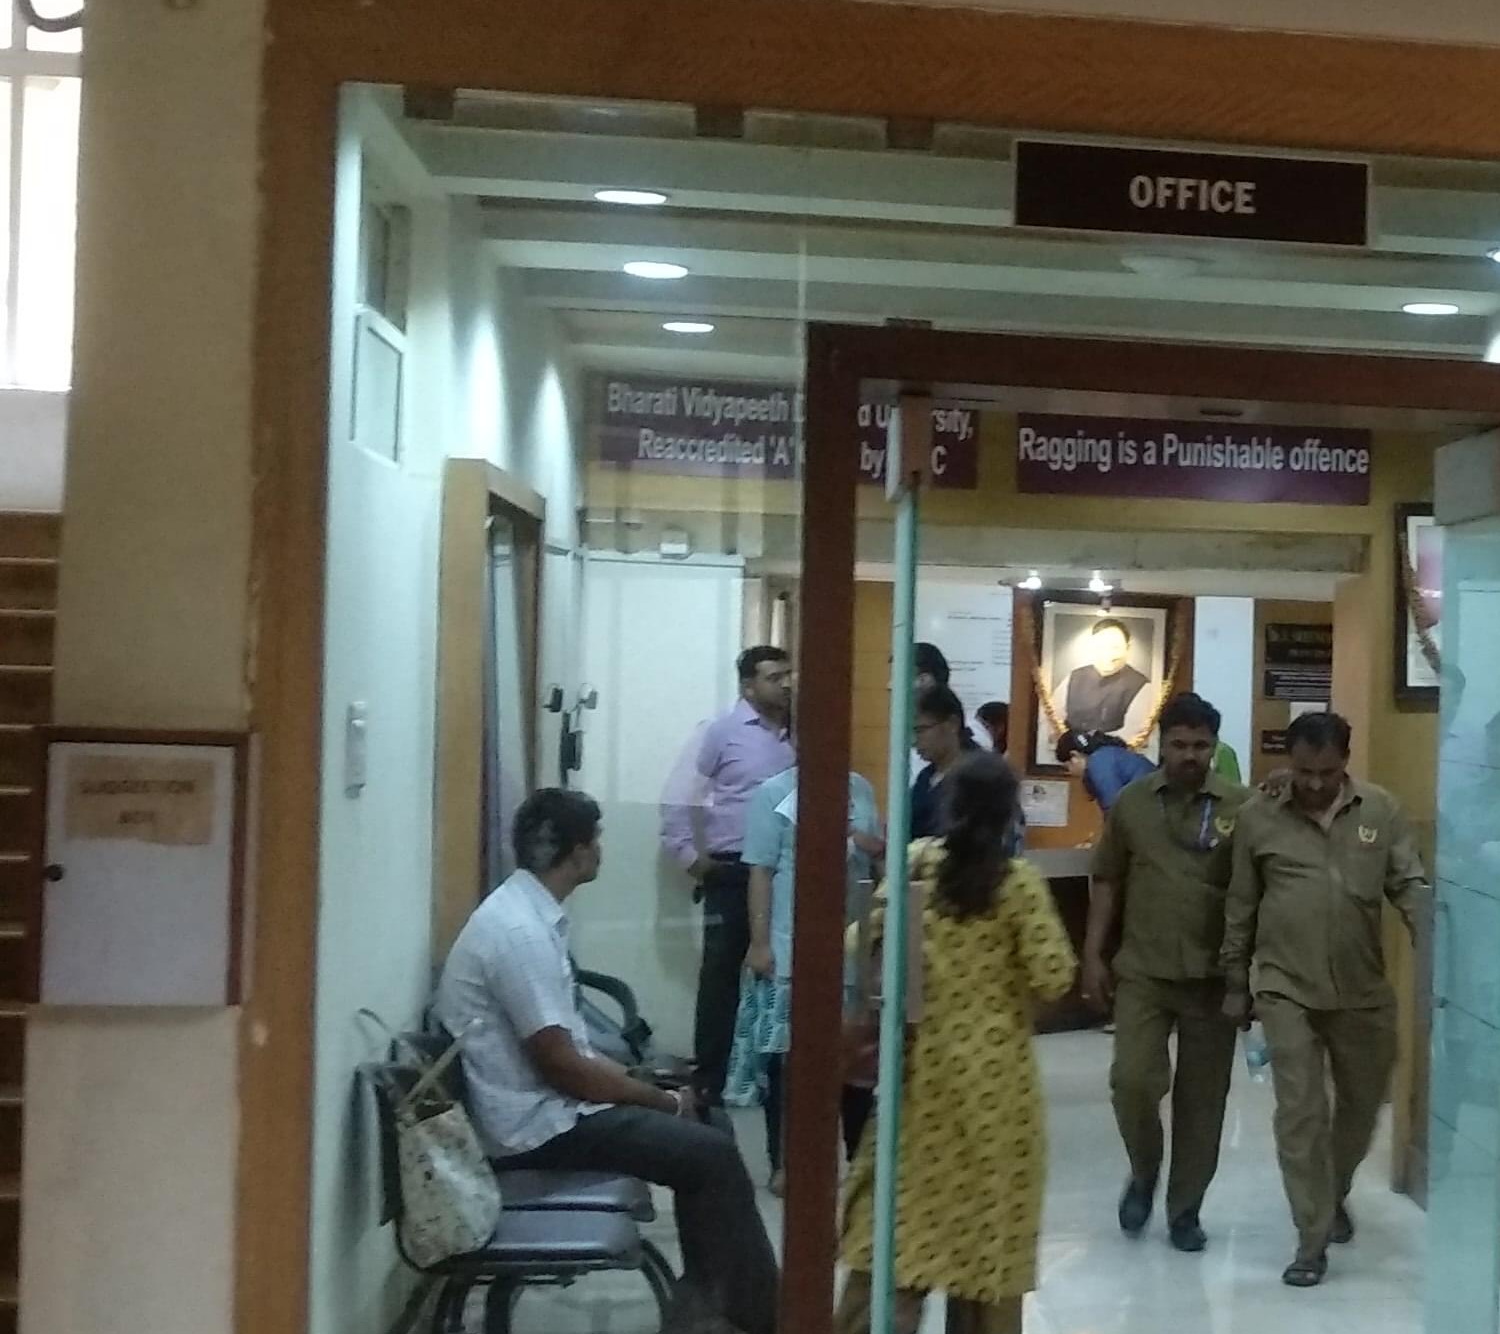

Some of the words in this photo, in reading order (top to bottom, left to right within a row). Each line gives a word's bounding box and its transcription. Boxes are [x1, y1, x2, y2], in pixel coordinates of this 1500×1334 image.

[1129, 175, 1257, 214] OFFICE
[608, 382, 678, 416] Bharati
[682, 386, 789, 426] Vidyapeeth
[638, 428, 765, 464] Reaccredited
[860, 441, 885, 479] by
[1018, 427, 1113, 473] Ragging
[1118, 431, 1138, 465] is
[1143, 440, 1157, 465] a
[1163, 433, 1285, 470] Punishable
[1289, 438, 1370, 474] offence
